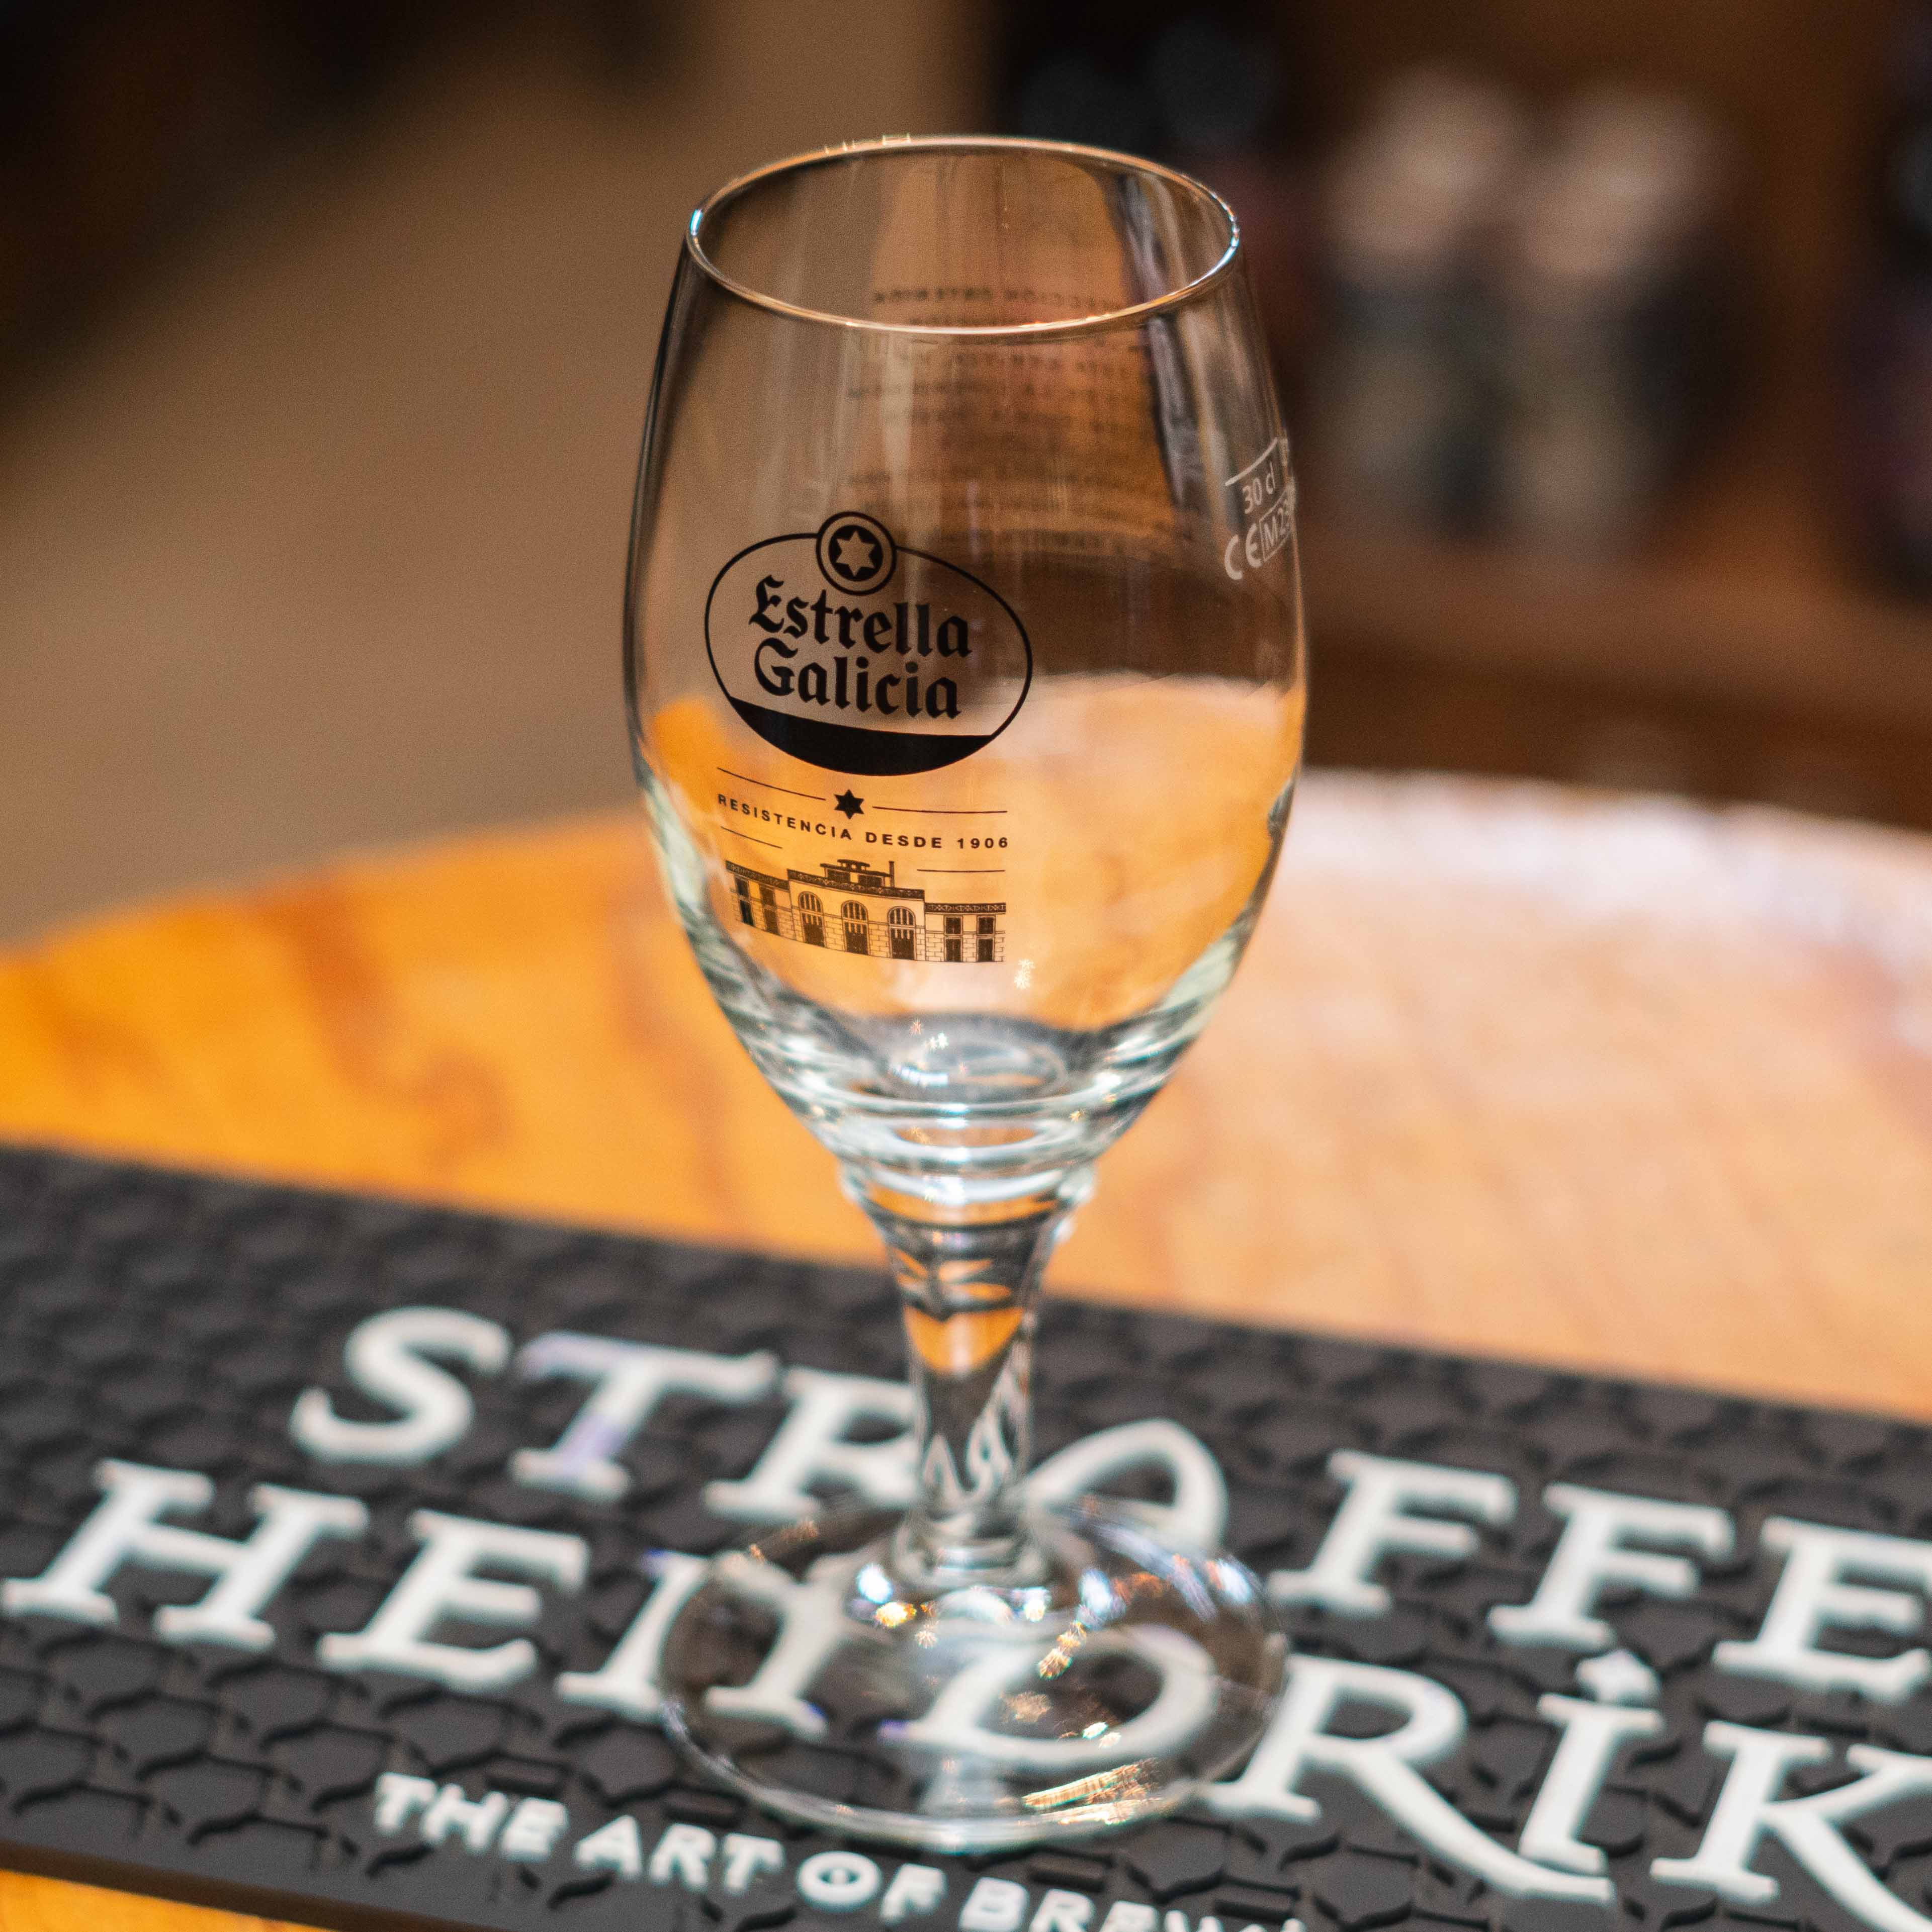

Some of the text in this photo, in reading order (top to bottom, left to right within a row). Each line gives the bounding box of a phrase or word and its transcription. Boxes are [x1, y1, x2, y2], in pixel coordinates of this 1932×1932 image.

[1242, 477, 1263, 515] 30
[1224, 522, 1263, 581] CE
[749, 575, 973, 658] Estrella
[754, 637, 961, 720] Galicia
[718, 794, 1008, 849] RESISTENCIA DESDE 1906
[375, 1772, 568, 1860] THE
[574, 1814, 783, 1895] ART
[797, 1851, 945, 1922] OF
